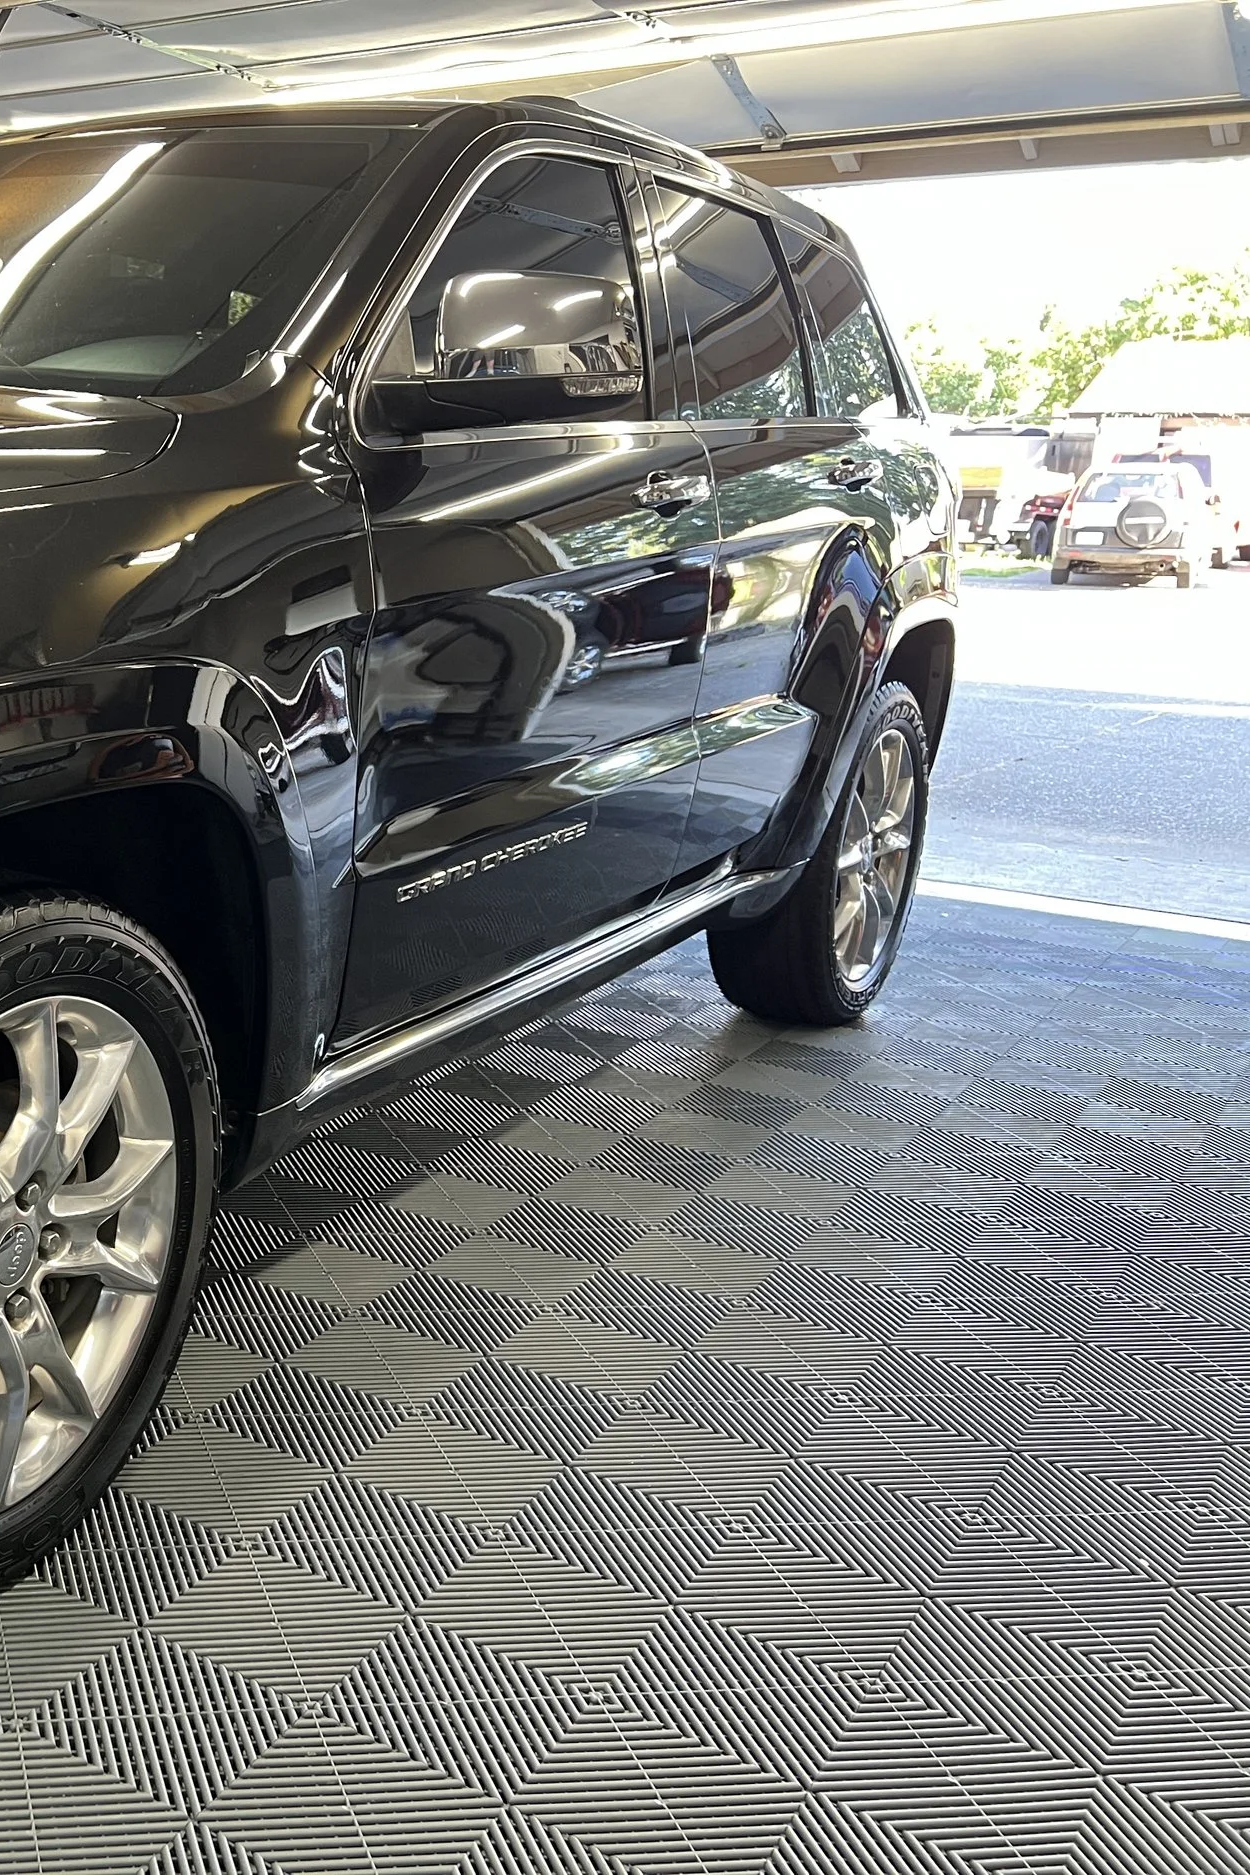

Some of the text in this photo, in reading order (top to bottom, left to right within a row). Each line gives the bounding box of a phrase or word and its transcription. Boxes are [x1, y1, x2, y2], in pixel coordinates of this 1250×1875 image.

[397, 821, 587, 903] GRAND CHEROKEE
[7, 1231, 27, 1277] Jeep
